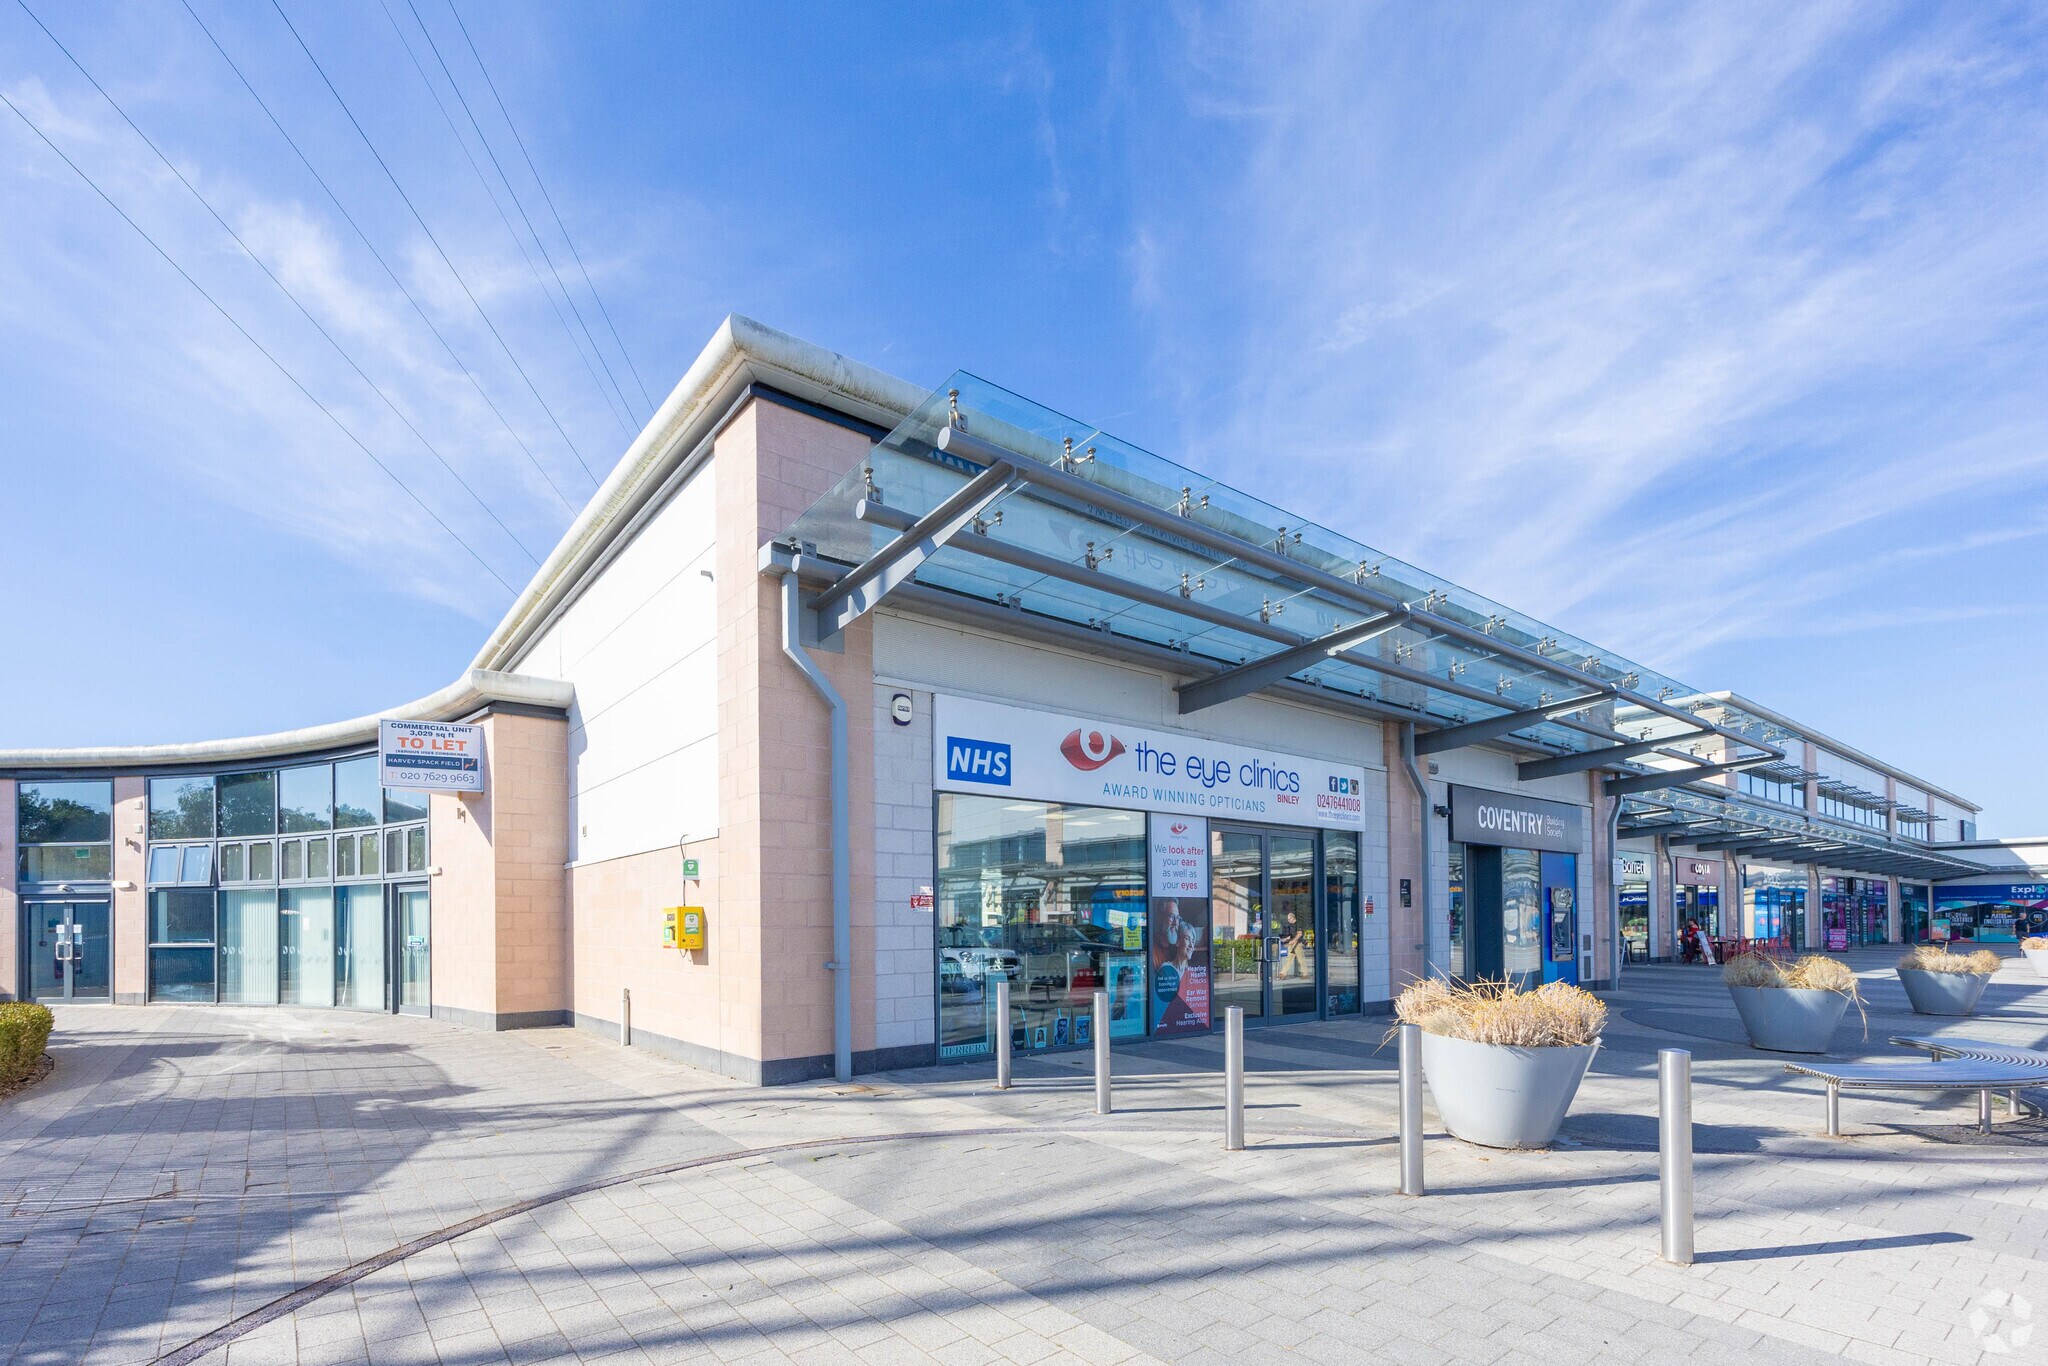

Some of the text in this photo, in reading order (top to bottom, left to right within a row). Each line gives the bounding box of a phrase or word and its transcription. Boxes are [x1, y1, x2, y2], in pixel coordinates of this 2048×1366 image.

[391, 722, 473, 734] COMMERCIAL UNIT
[397, 736, 468, 752] TO LET
[950, 746, 1008, 777] NHS
[1135, 741, 1300, 793] the eye clinics
[400, 771, 421, 780] 020
[423, 771, 448, 783] 7629
[450, 773, 475, 785] 9663
[1103, 782, 1267, 813] AWARD WINNING OPTICIANS
[1277, 793, 1300, 805] BINLEY
[1316, 794, 1361, 812] 02476441008
[1478, 805, 1543, 836] COVENTRY
[1546, 814, 1565, 829] Building
[1546, 826, 1564, 840] Society
[1154, 844, 1205, 856] We look after
[1162, 859, 1197, 867] your ears
[1162, 869, 1198, 878] as well as
[1162, 881, 1198, 891] your eyes
[2011, 885, 2048, 895] Explo
